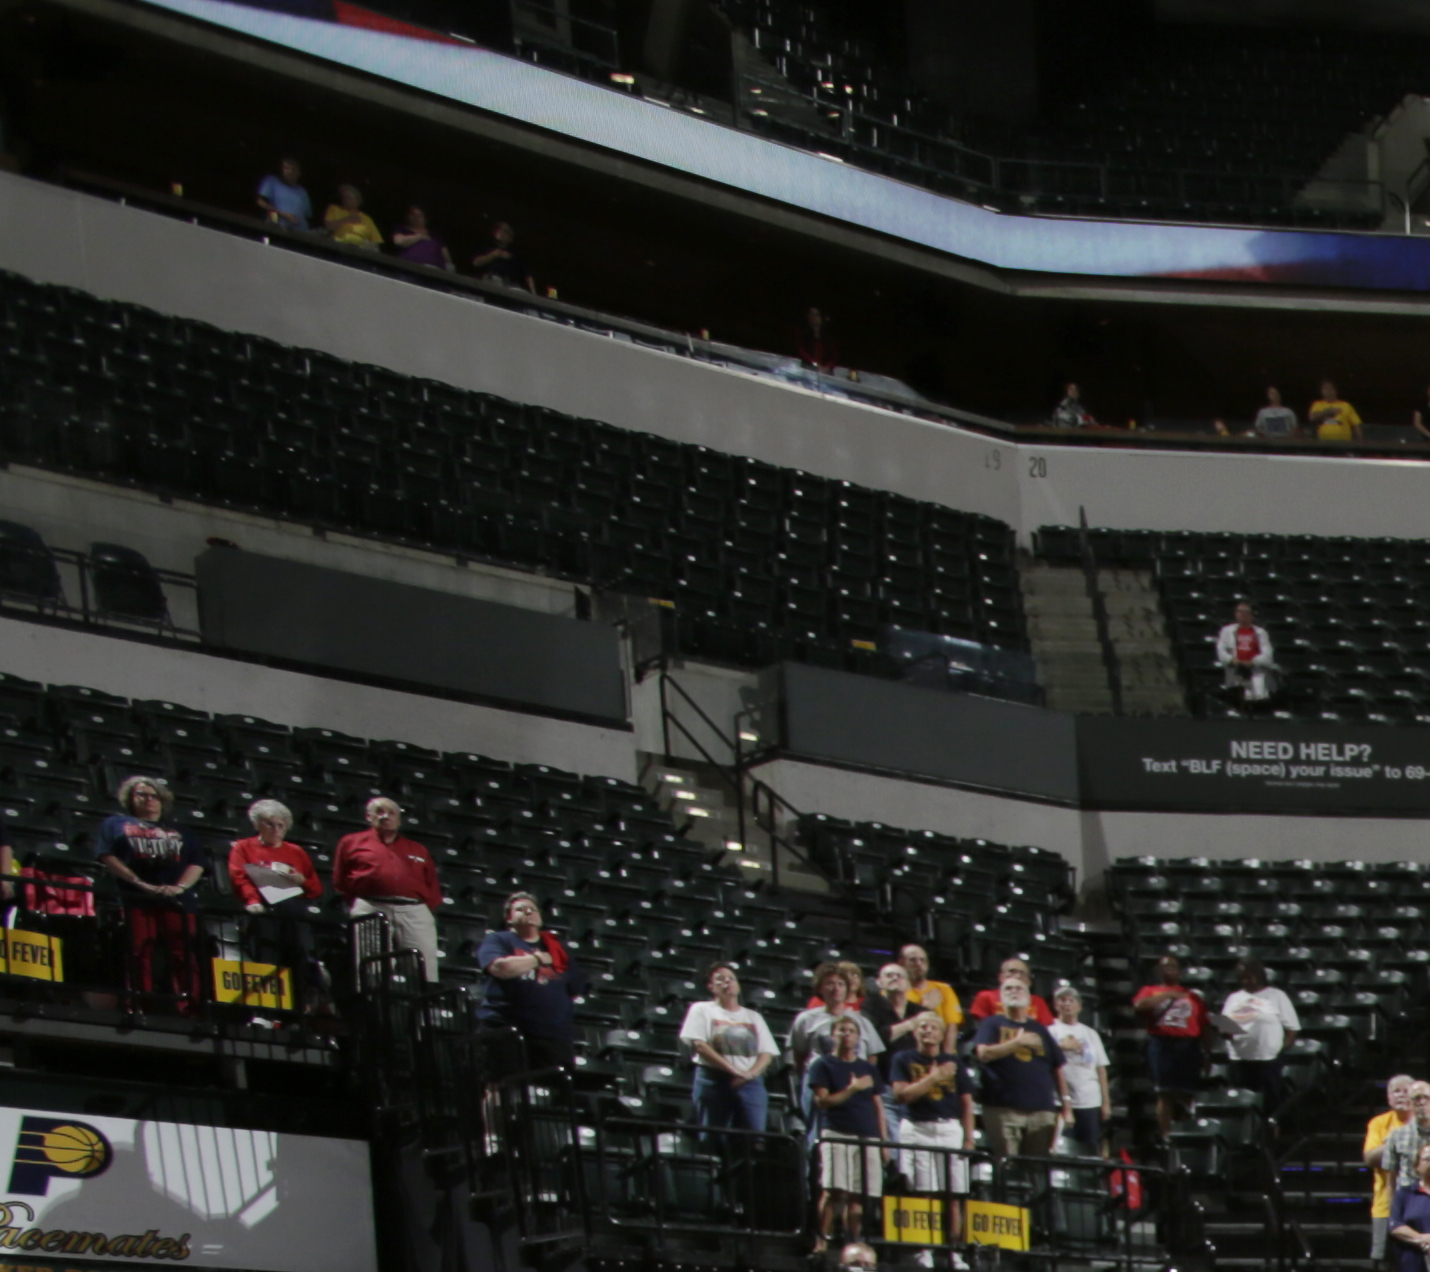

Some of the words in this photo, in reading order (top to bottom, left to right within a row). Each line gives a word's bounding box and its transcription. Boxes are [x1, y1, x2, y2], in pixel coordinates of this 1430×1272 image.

[1029, 456, 1046, 478] 20
[1230, 740, 1294, 760] NEED
[1299, 742, 1372, 764] HELP?
[1142, 758, 1176, 773] Text
[1225, 762, 1284, 781] (space)
[1288, 766, 1325, 782] your
[1384, 766, 1401, 779] to
[222, 969, 244, 991] GO
[892, 1209, 911, 1228] GO
[914, 1210, 948, 1230] FEVE
[973, 1214, 989, 1234] GO
[992, 1215, 1023, 1237] FEVER
